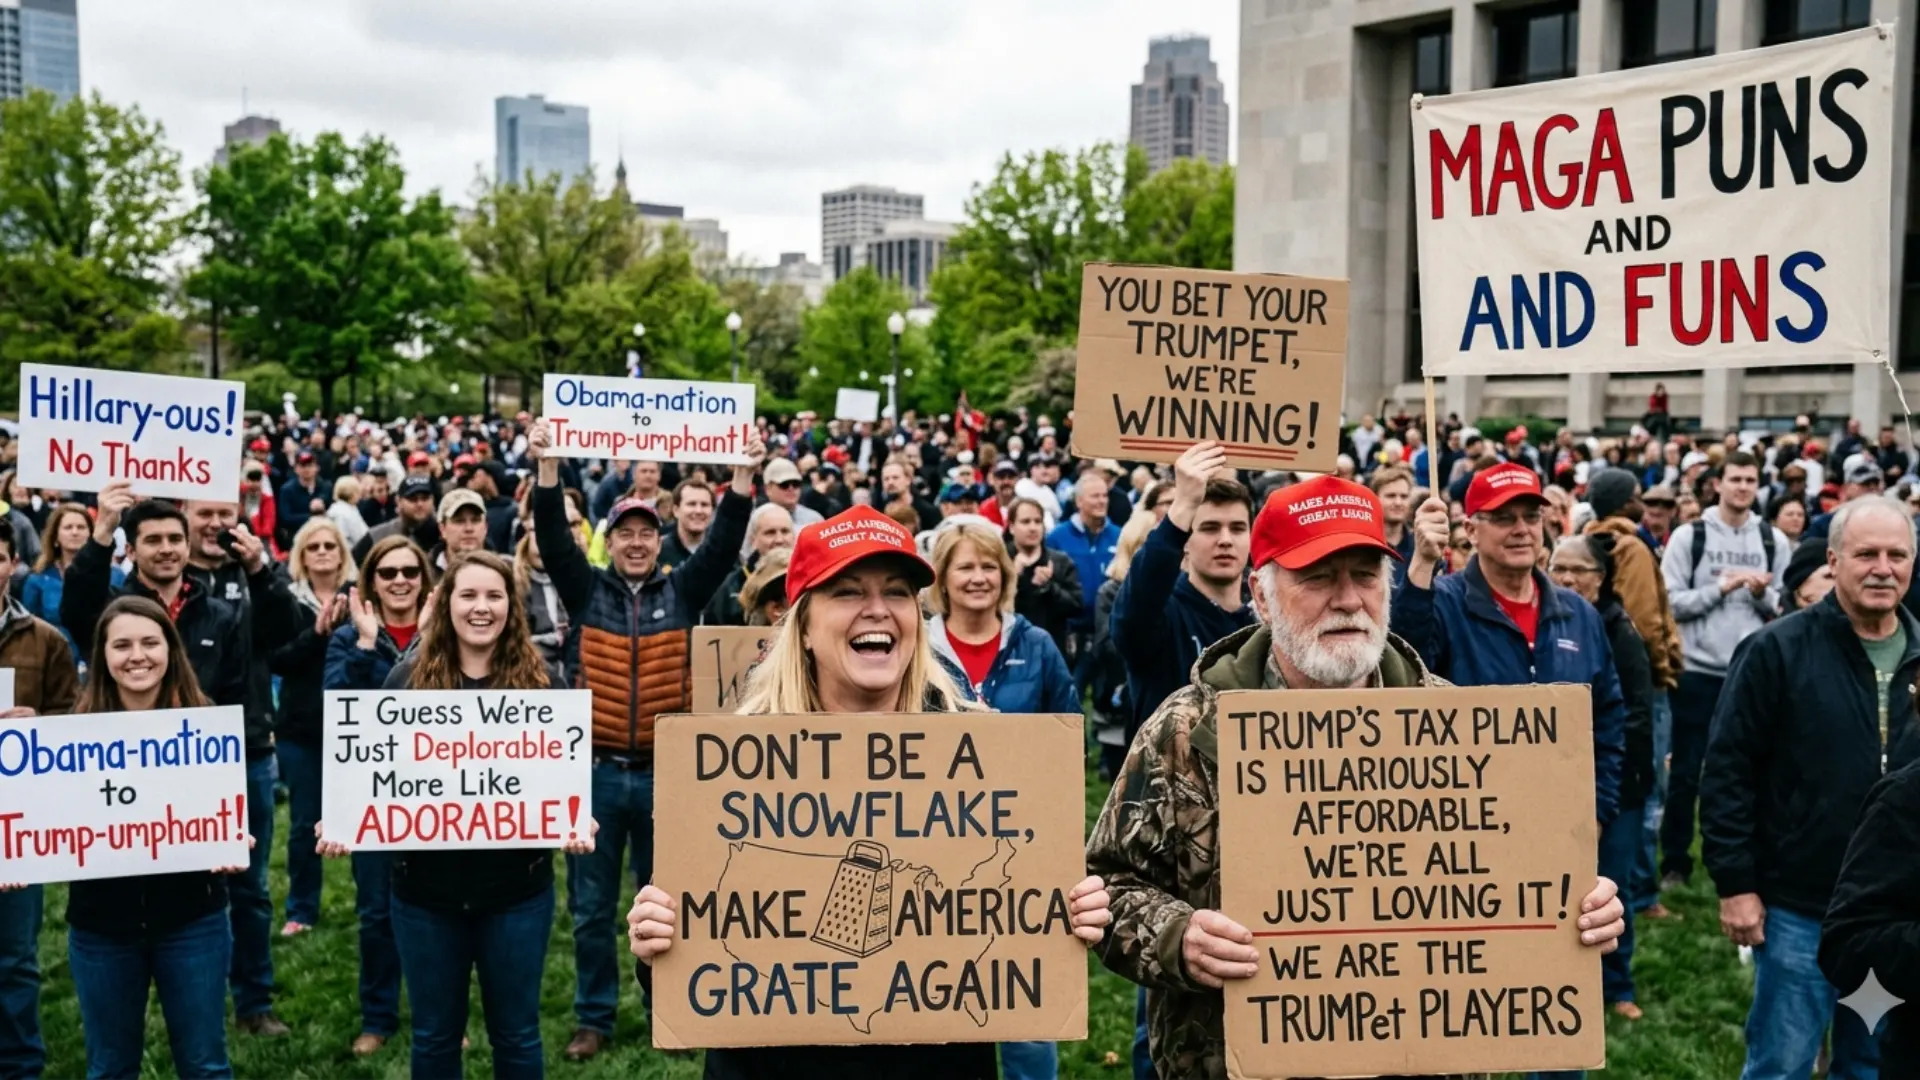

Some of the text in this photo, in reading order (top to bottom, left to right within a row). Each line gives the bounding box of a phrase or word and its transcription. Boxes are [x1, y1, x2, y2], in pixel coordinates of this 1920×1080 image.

[1429, 68, 1870, 220] MAGA PUNS
[1584, 214, 1672, 255] AND
[1098, 275, 1328, 325] YOU BET YOUR
[1459, 251, 1829, 351] AND FUNS
[1127, 320, 1300, 370] TRUMPET,
[555, 379, 736, 415] Obama-nation
[1165, 364, 1256, 396] WE'RE
[30, 375, 237, 442] Hillary-ous!
[632, 412, 652, 427] to
[1112, 393, 1320, 449] WINNING!
[48, 438, 212, 486] No Thanks
[336, 694, 554, 726] I Guess We're
[1228, 706, 1557, 751] TRUMP'S TAX PLAN
[0, 719, 241, 776] Obama-nation
[334, 726, 585, 769] Just Deplorable?
[695, 729, 984, 781] DON'T BE A
[100, 778, 137, 806] to
[373, 768, 522, 798] More Like
[1236, 753, 1491, 794] IS HILARIOUSLY
[0, 794, 245, 867] Trump-umphant!
[355, 795, 582, 844] ADORABLE!
[717, 790, 1035, 843] SNOWFLAKE,
[1293, 797, 1511, 836] AFFORDABLE,
[1304, 841, 1490, 878] WE'RE ALL
[681, 888, 1073, 940] MAKE AMERICA
[1263, 873, 1571, 925] JUST LOVING IT!
[1268, 939, 1487, 981] WE ARE THE
[688, 958, 1041, 1016] GRATE AGAIN
[1247, 985, 1582, 1044] TRUMPet PLAYERS
